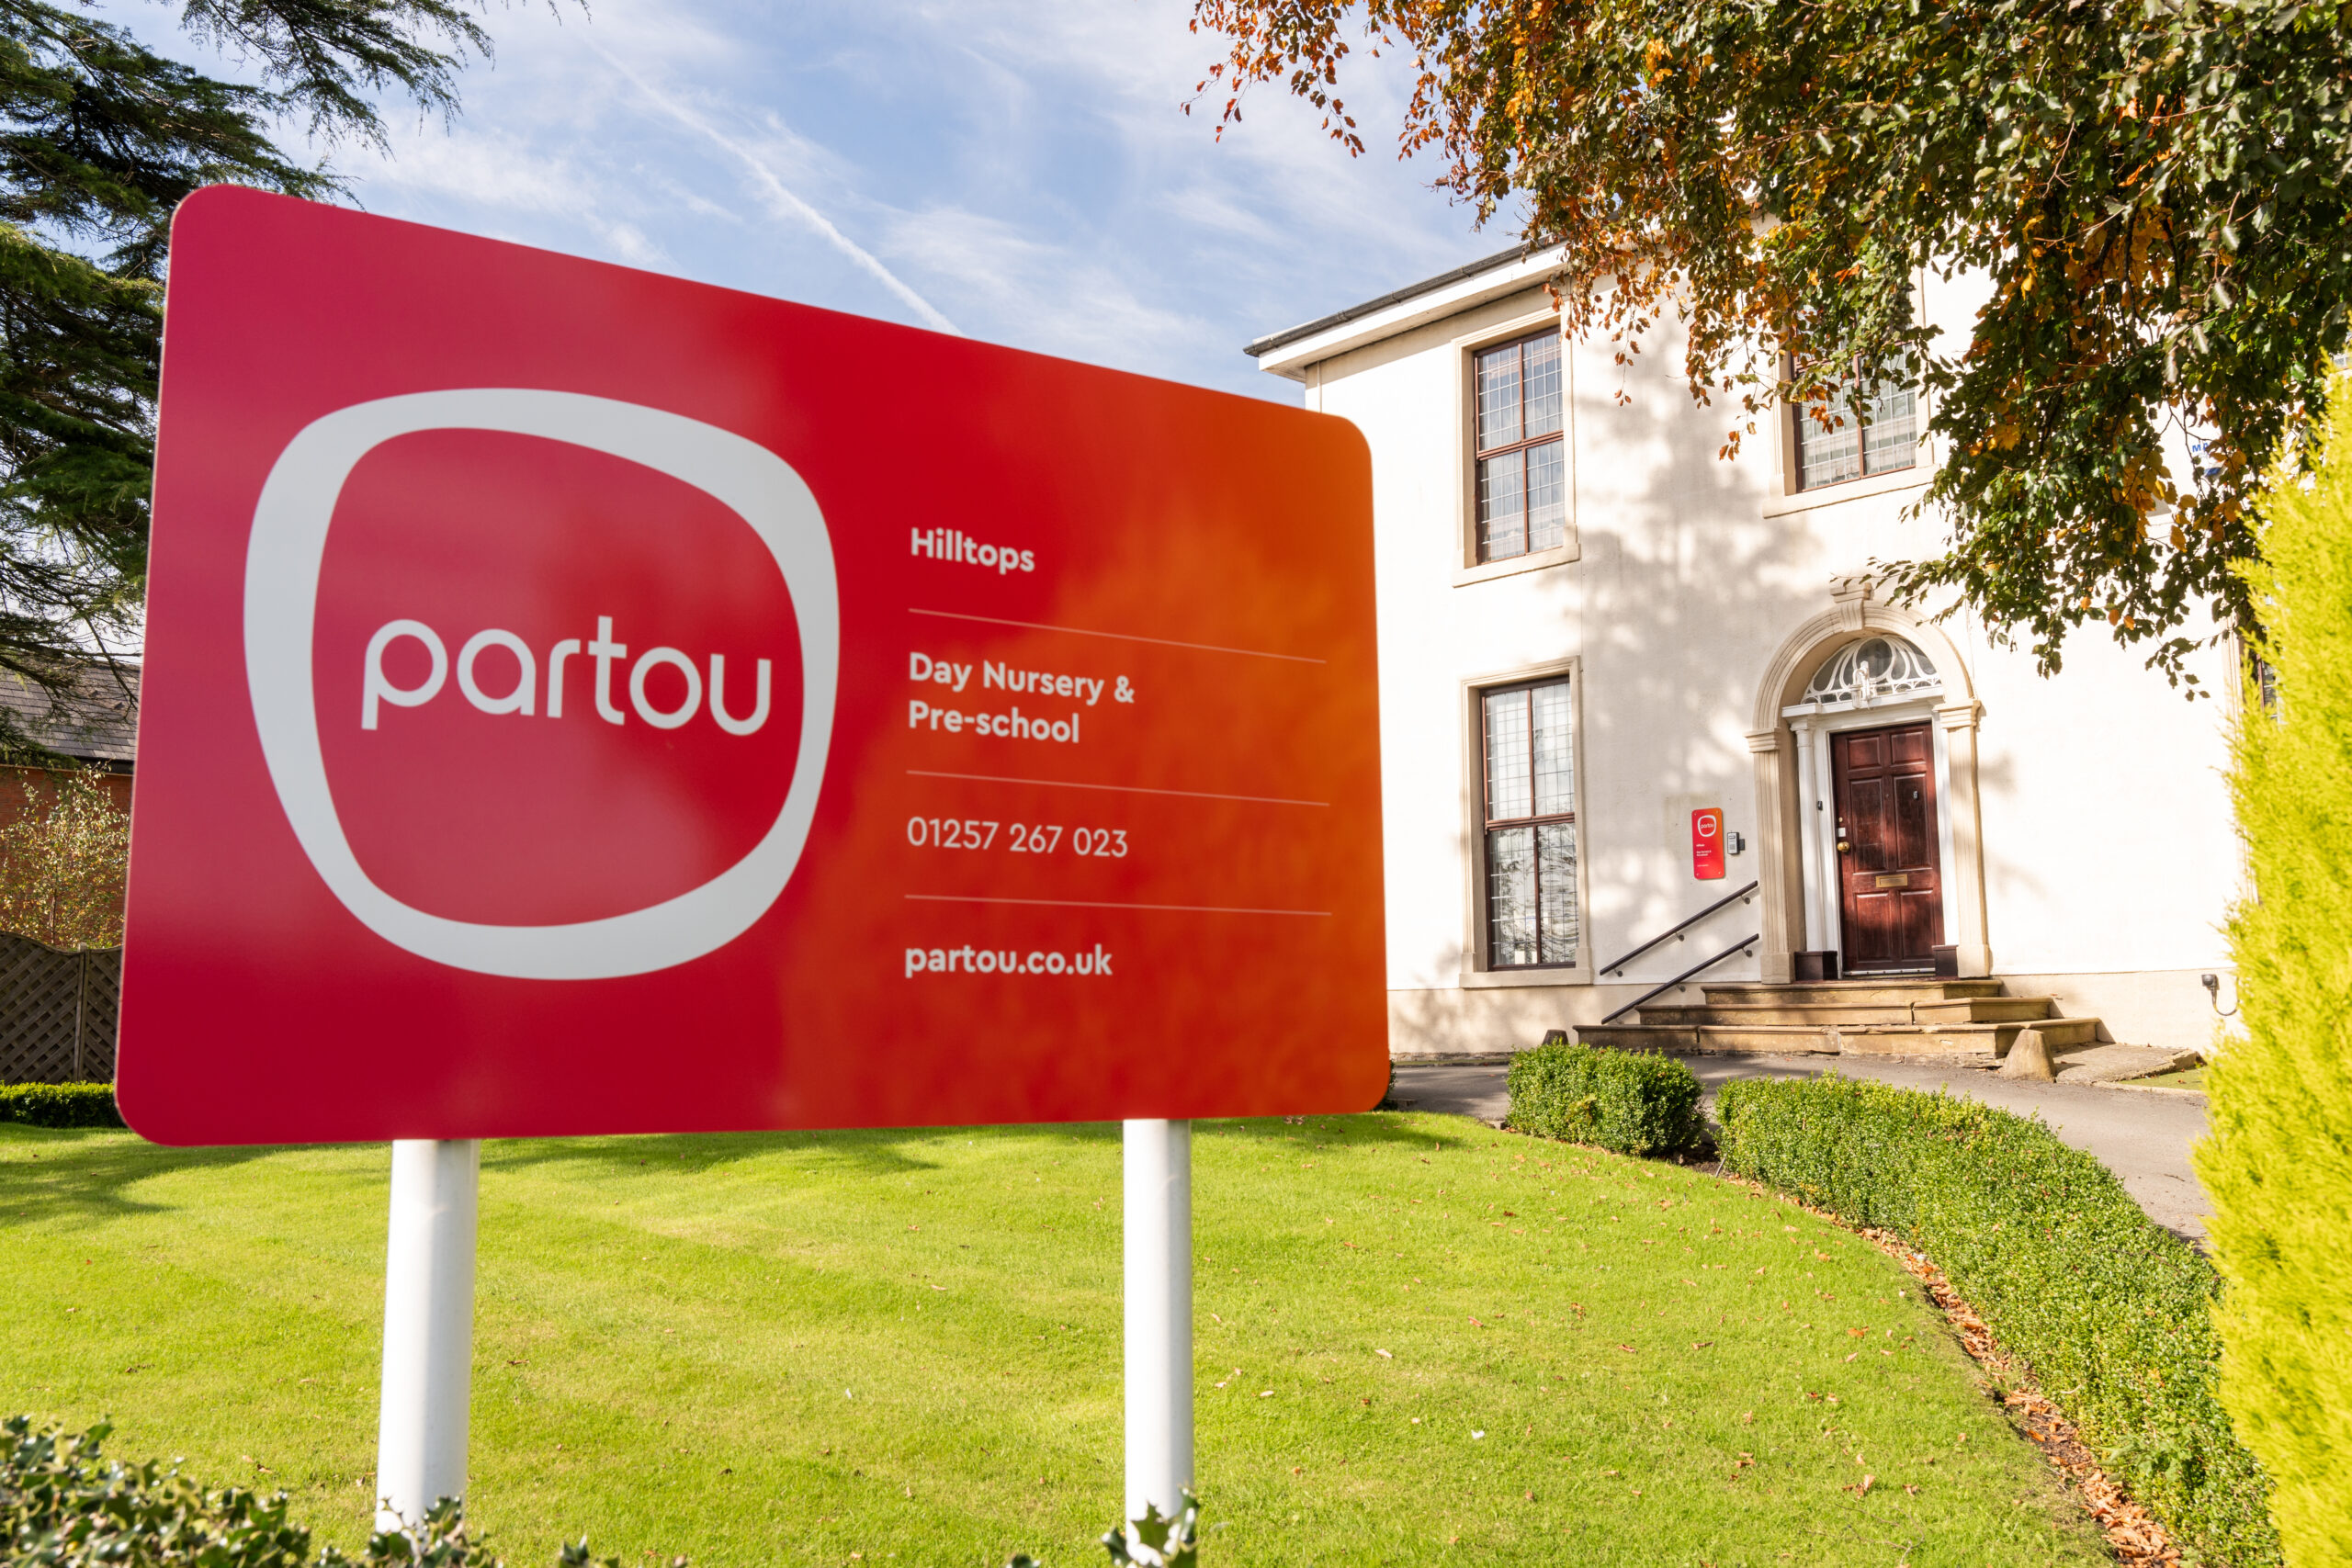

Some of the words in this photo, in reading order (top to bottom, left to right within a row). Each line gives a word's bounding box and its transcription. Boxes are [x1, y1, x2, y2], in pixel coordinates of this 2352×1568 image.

[910, 527, 1035, 575] Hilltops
[360, 615, 772, 737] partou
[910, 651, 973, 693] Day
[983, 660, 1105, 706] Nursery
[1114, 675, 1136, 704] &
[909, 699, 1080, 743] Pre-school
[907, 816, 1000, 850] 01257
[1010, 822, 1063, 853] 267
[1073, 827, 1129, 858] 023
[905, 943, 1113, 978] partou.co.uk
